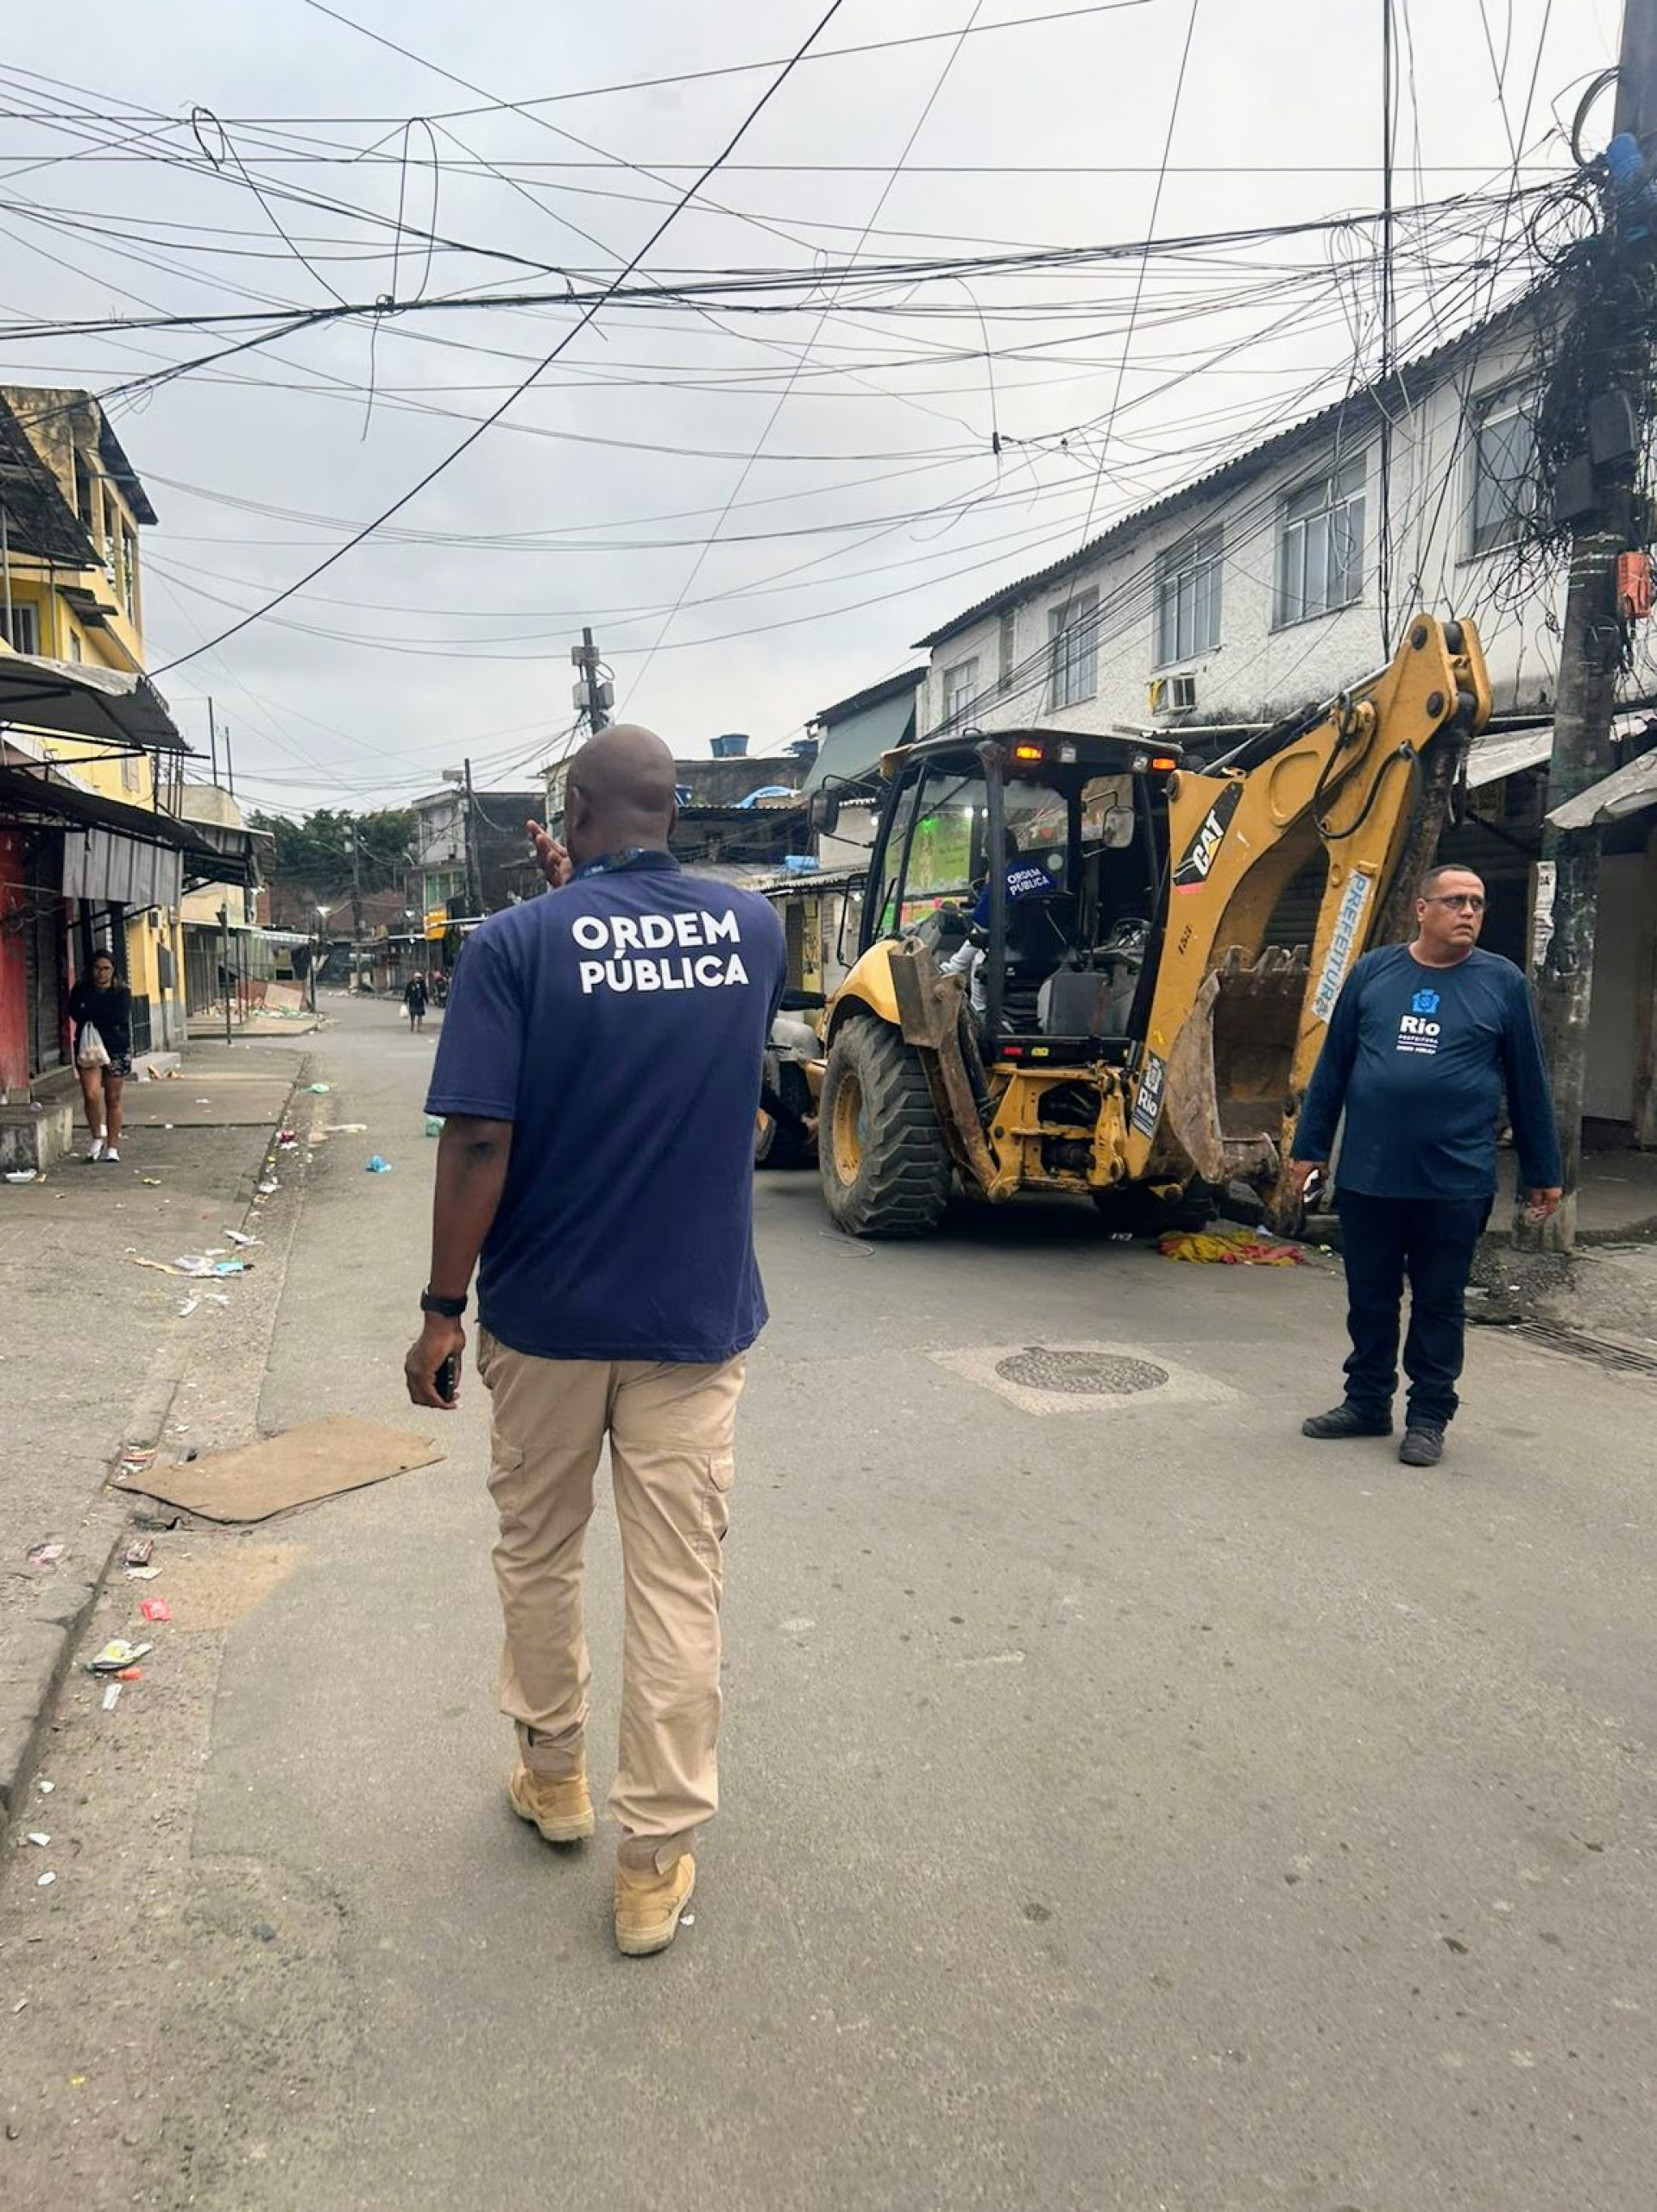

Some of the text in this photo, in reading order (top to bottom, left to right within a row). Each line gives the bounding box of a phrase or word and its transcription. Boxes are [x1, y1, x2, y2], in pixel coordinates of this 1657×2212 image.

[1193, 809, 1225, 877] CAT
[1007, 867, 1042, 884] ORDEM
[571, 910, 740, 950] ORDEM
[1314, 873, 1367, 1018] PREFEITURA
[579, 948, 750, 993] PÚBLICA
[1399, 1015, 1441, 1037] Rio
[1137, 1087, 1157, 1117] Rio
